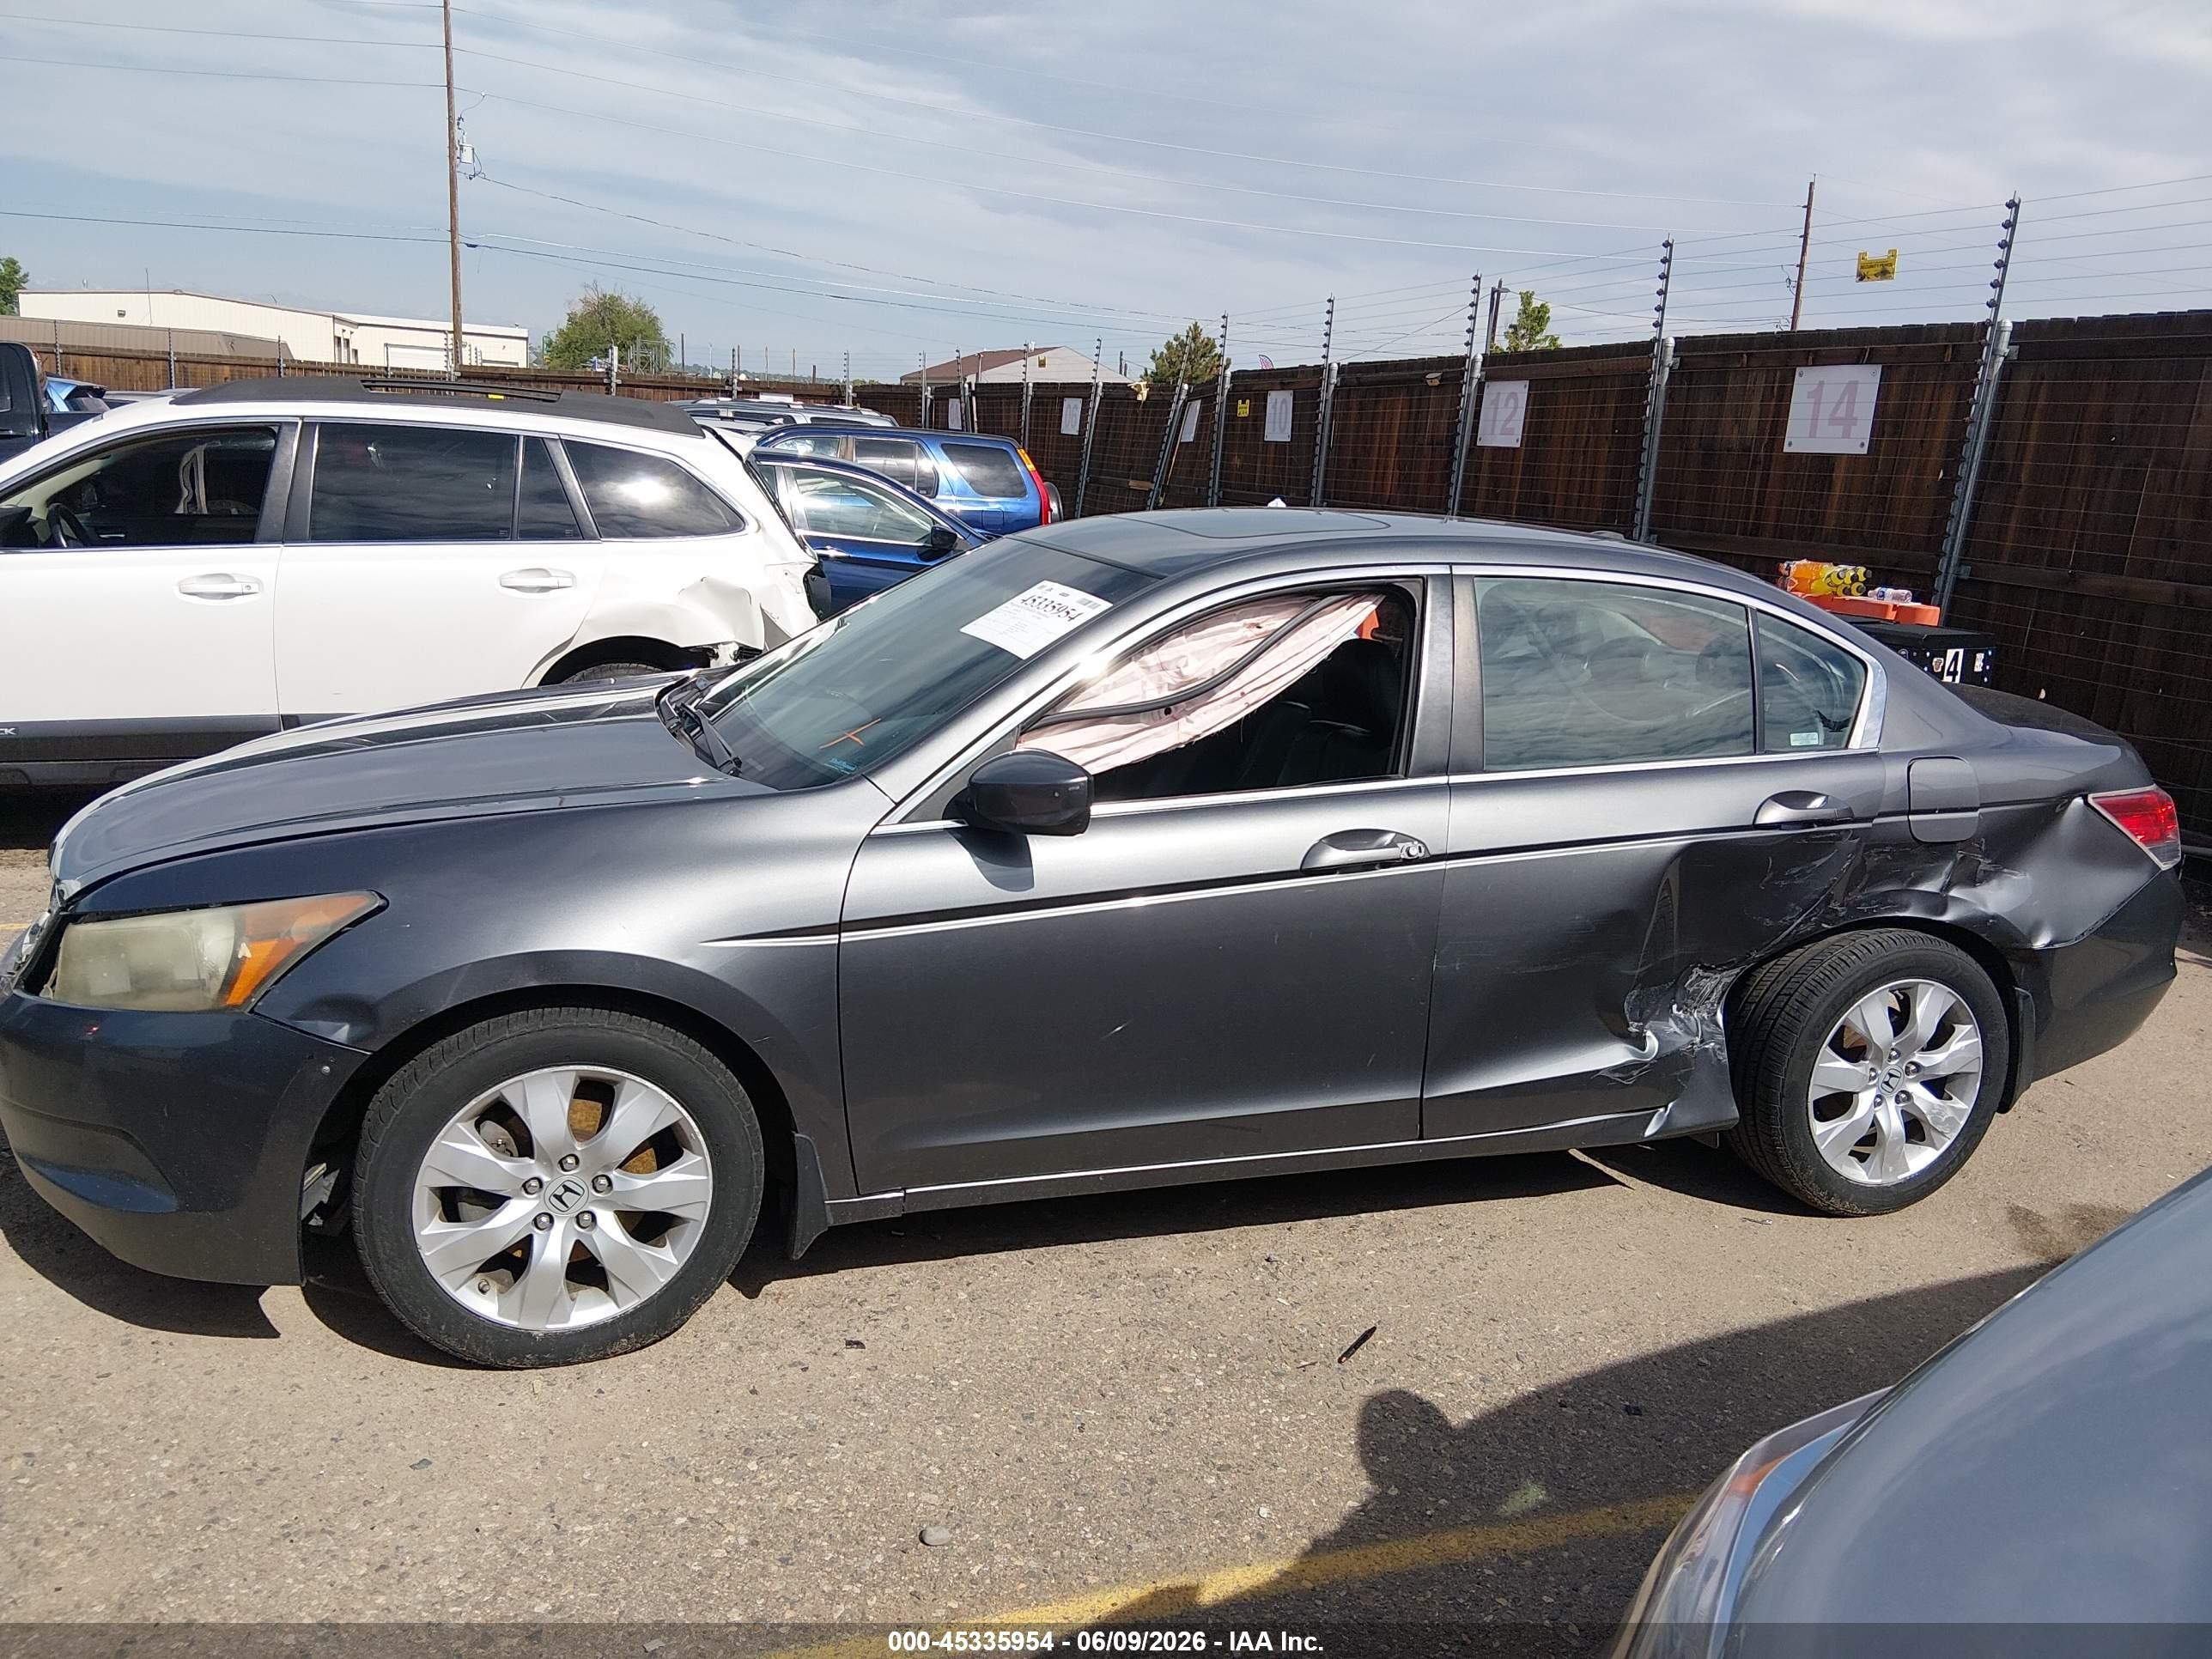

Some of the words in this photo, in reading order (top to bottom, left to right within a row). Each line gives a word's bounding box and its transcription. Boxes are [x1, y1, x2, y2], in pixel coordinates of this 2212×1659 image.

[1271, 398, 1288, 433] 10
[1491, 392, 1519, 435] 12
[1807, 380, 1859, 439] 14
[1020, 595, 1085, 622] 45335954
[1945, 651, 1960, 683] 4
